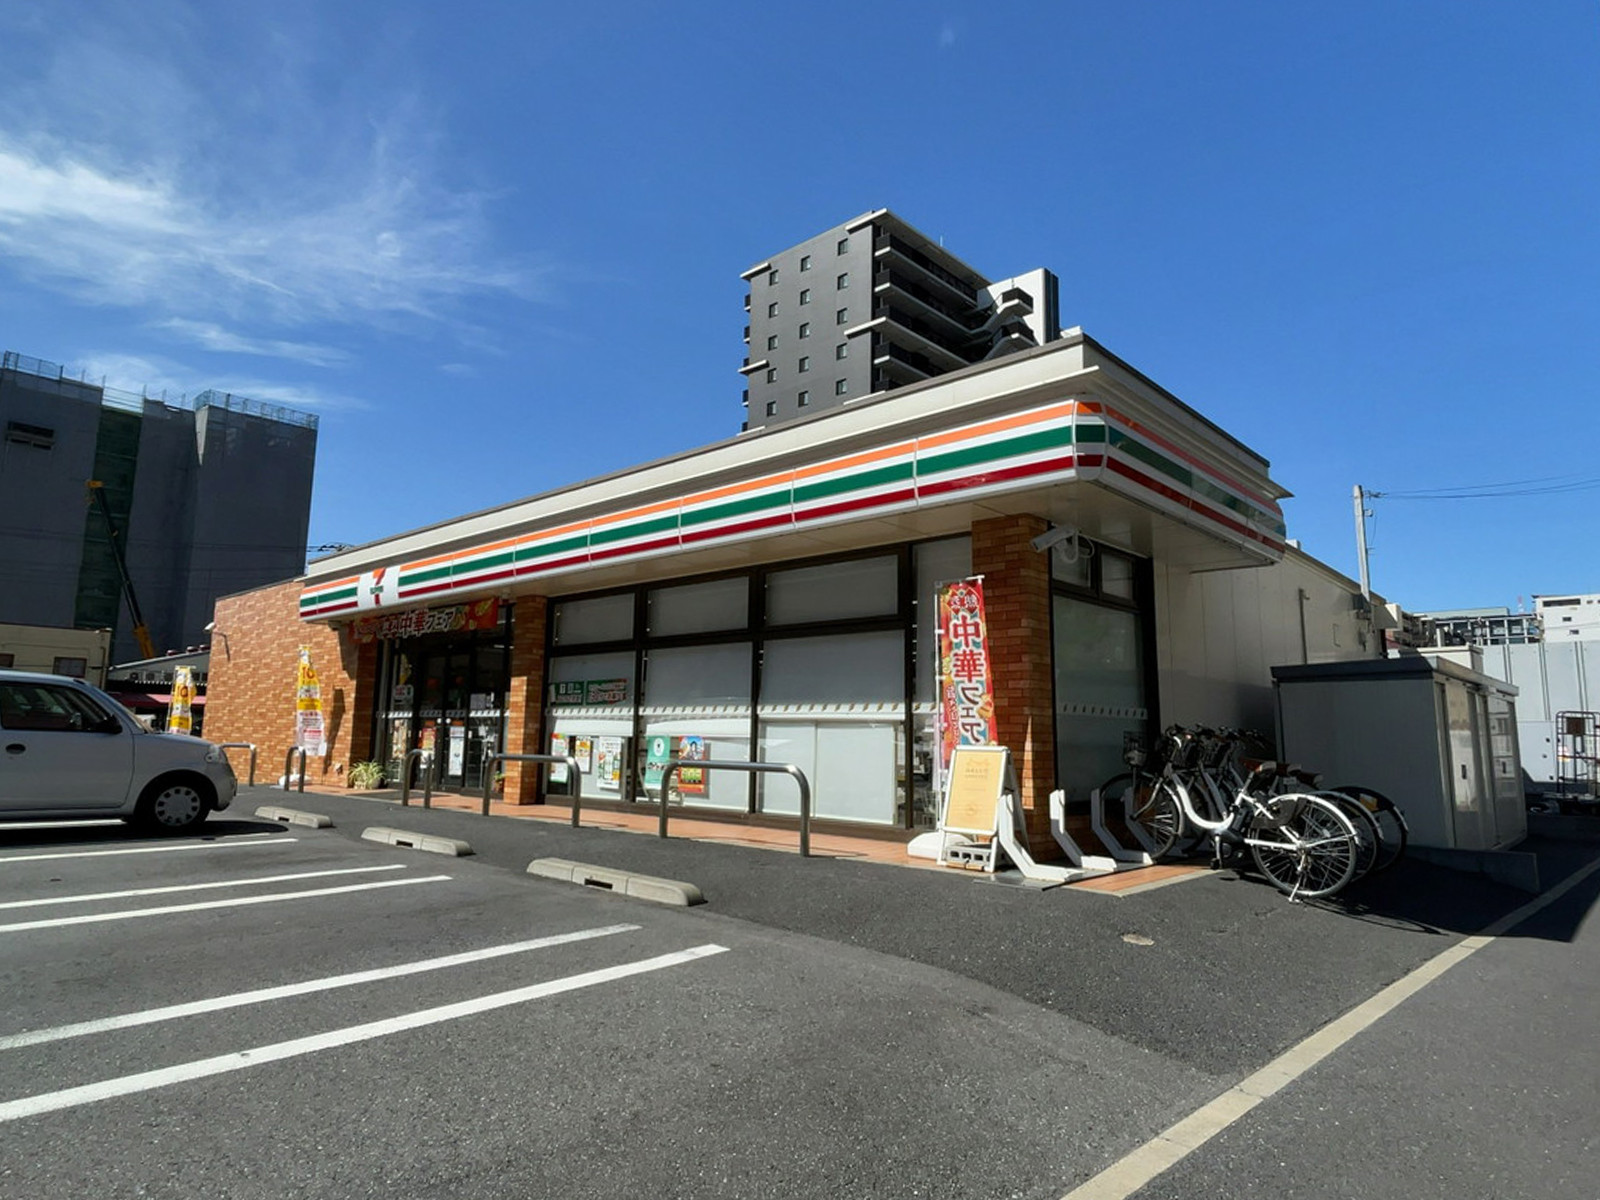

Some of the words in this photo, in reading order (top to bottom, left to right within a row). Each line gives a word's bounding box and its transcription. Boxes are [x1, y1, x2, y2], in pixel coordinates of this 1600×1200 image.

[951, 612, 984, 745] 中華フェア
